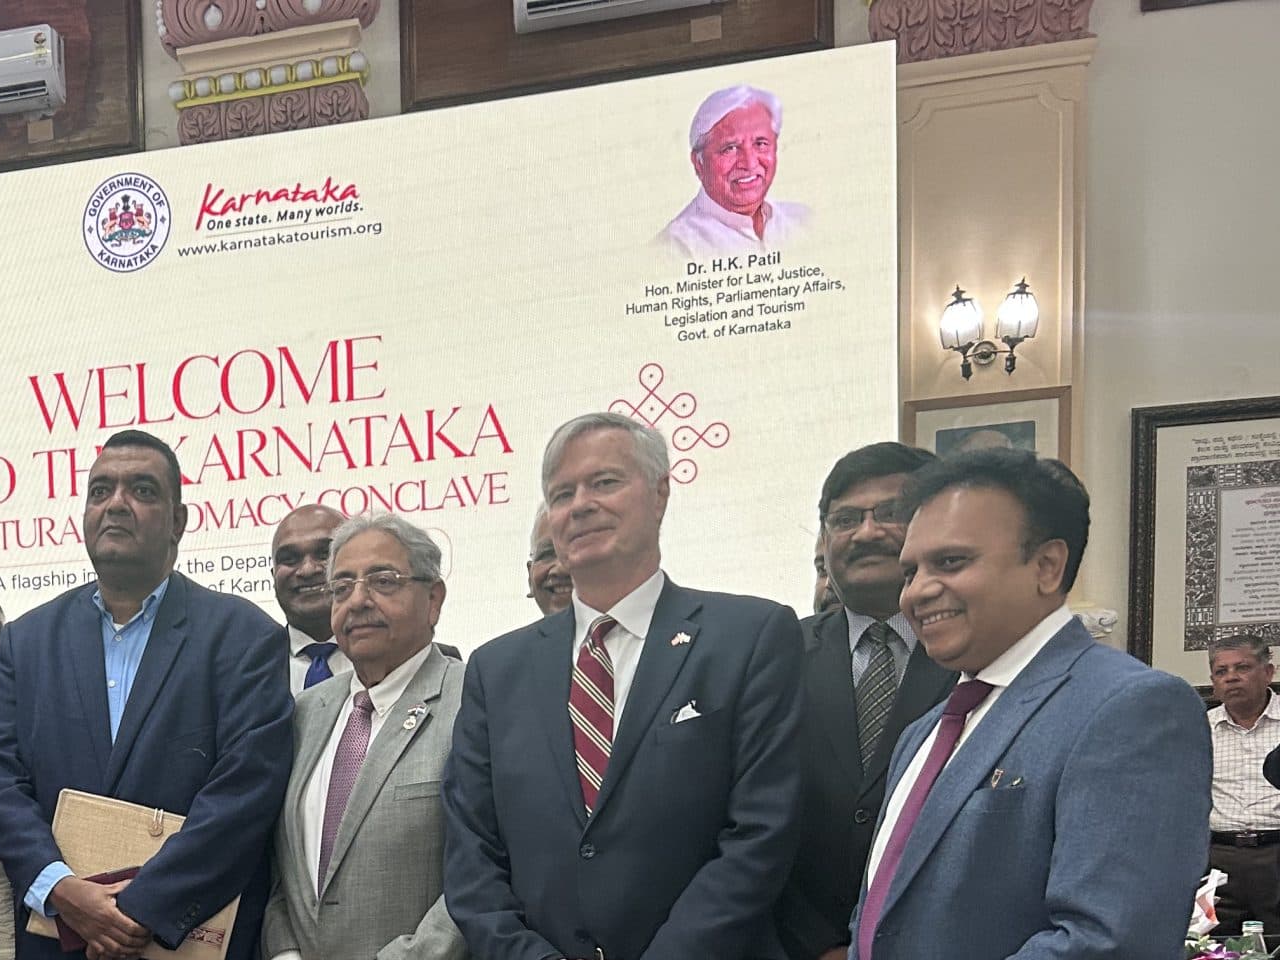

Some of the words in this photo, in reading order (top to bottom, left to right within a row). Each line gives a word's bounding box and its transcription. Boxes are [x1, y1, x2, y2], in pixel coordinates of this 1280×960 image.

[88, 176, 154, 217] GOVERNMENT
[152, 192, 166, 209] OF
[195, 176, 360, 231] Karnataka
[206, 219, 231, 231] One
[235, 213, 272, 227] state.
[277, 208, 312, 223] Many
[315, 200, 364, 217] worlds.
[97, 243, 159, 269] KARNATAKA
[178, 222, 382, 257] www.karnatakatourism.org
[687, 262, 707, 275] Dr.
[712, 257, 742, 272] H.K.
[748, 251, 781, 268] Patil
[626, 302, 667, 315] Human
[671, 296, 712, 310] Rights,
[716, 284, 800, 304] Parliamentary
[803, 279, 845, 294] Affairs,
[645, 285, 673, 297] Hon.
[676, 279, 724, 294] Minister
[726, 275, 743, 287] for
[746, 273, 774, 285] Law,
[777, 266, 824, 281] Justice,
[664, 310, 728, 327] Legislation
[731, 305, 753, 319] and
[757, 301, 805, 316] Tourism
[677, 329, 709, 341] Govt.
[713, 325, 726, 337] of
[728, 319, 791, 336] Karnataka
[27, 334, 386, 434] WELCOME
[33, 445, 103, 499] TH
[185, 491, 306, 533] OMACY
[12, 570, 77, 590] flagship
[187, 558, 215, 574] the
[221, 555, 272, 572] Depar
[208, 579, 225, 593] of
